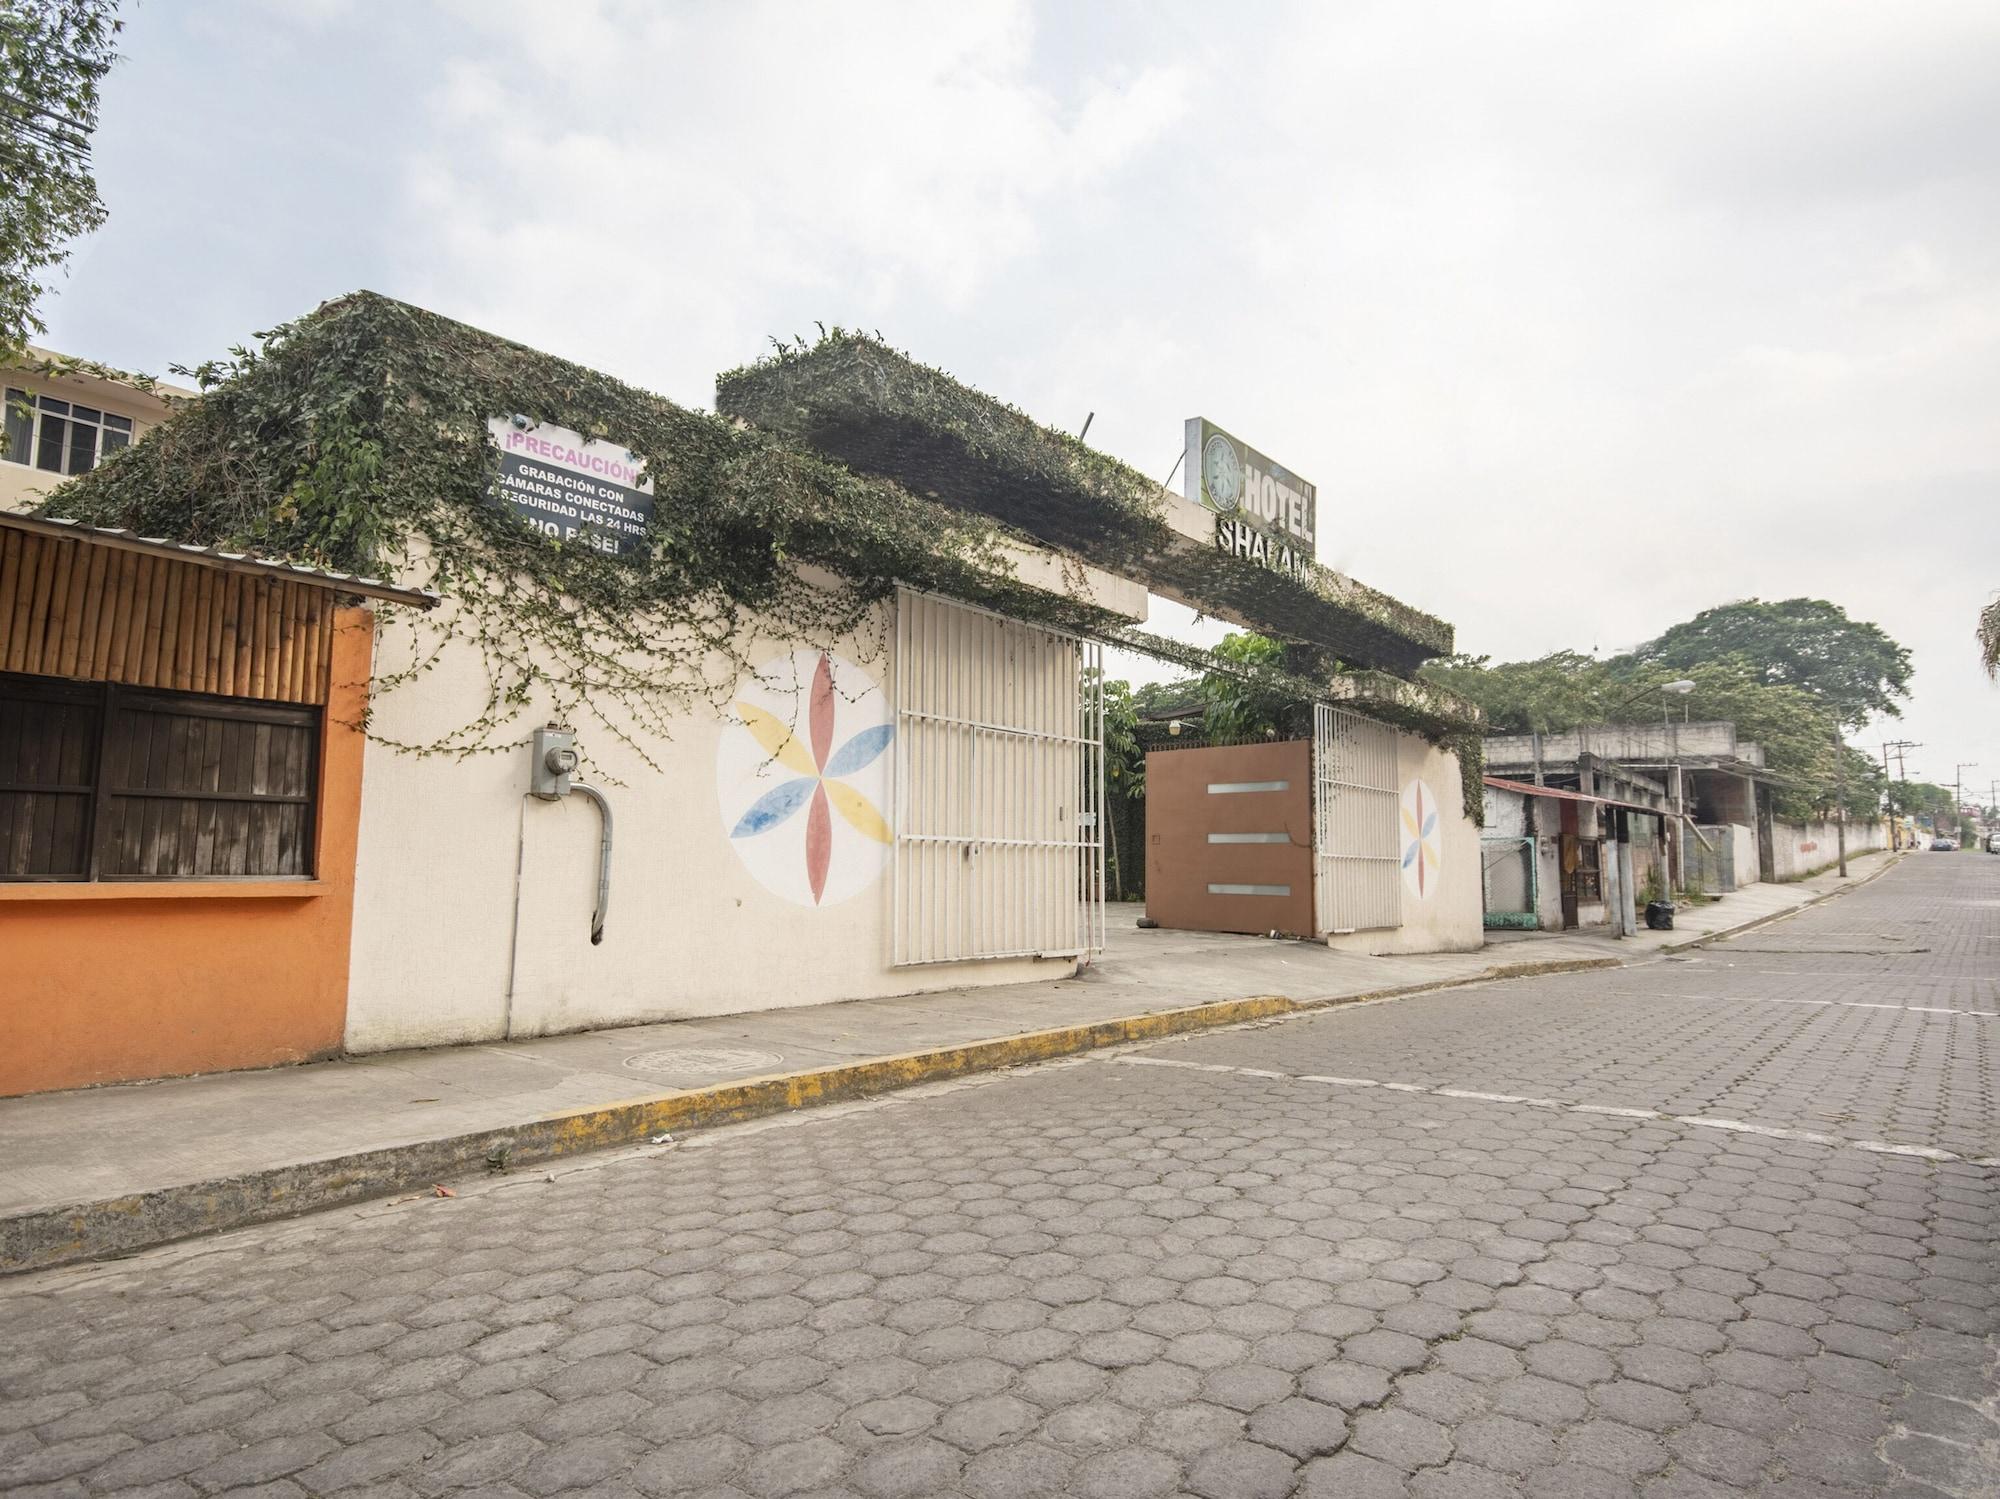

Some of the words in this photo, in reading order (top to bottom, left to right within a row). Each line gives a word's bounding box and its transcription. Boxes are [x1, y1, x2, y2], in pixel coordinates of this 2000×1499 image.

[497, 472, 562, 499] CÁMARAS
[565, 492, 645, 523] CONECTADAS
[519, 464, 596, 495] GRABACIÓN
[599, 487, 624, 503] CON
[565, 526, 620, 554] PSE!
[580, 510, 604, 525] LAS
[606, 518, 621, 530] 24
[623, 522, 647, 537] HRS
